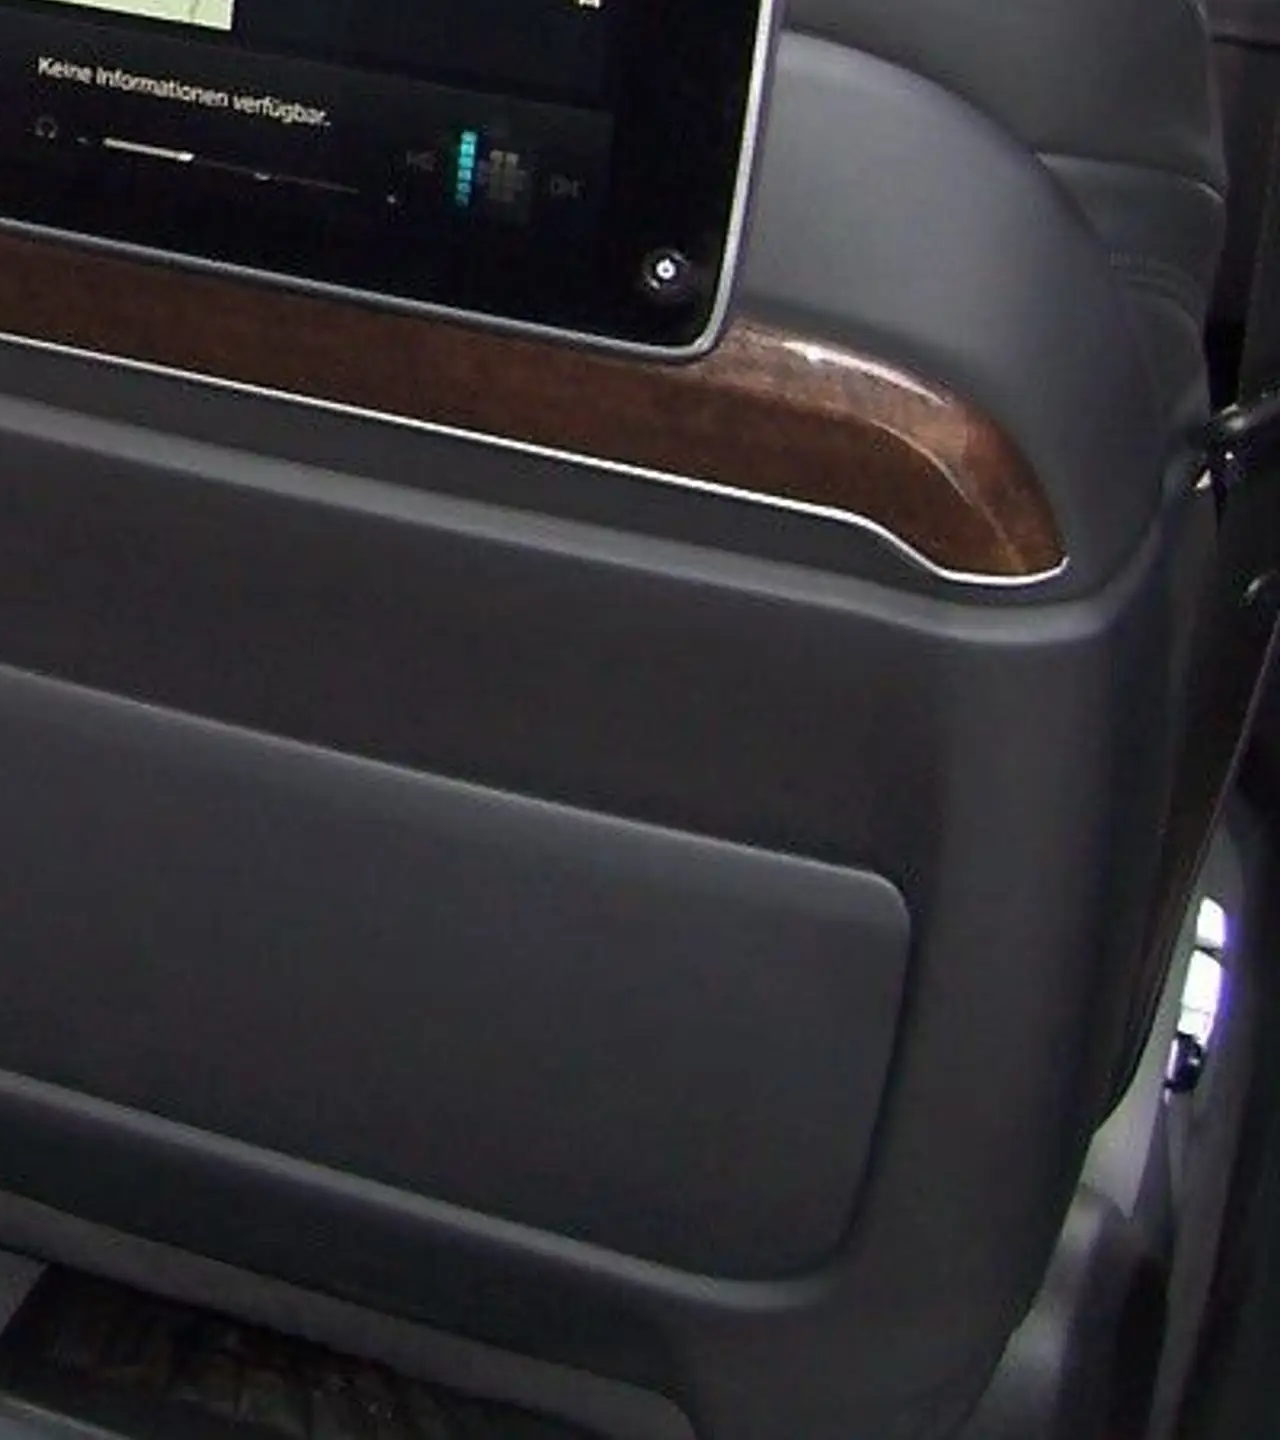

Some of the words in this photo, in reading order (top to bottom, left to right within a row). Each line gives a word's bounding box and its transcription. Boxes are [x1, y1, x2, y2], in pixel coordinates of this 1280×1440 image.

[37, 56, 93, 84] Keine
[95, 66, 229, 109] Informationen
[233, 93, 333, 127] verfügbar.
